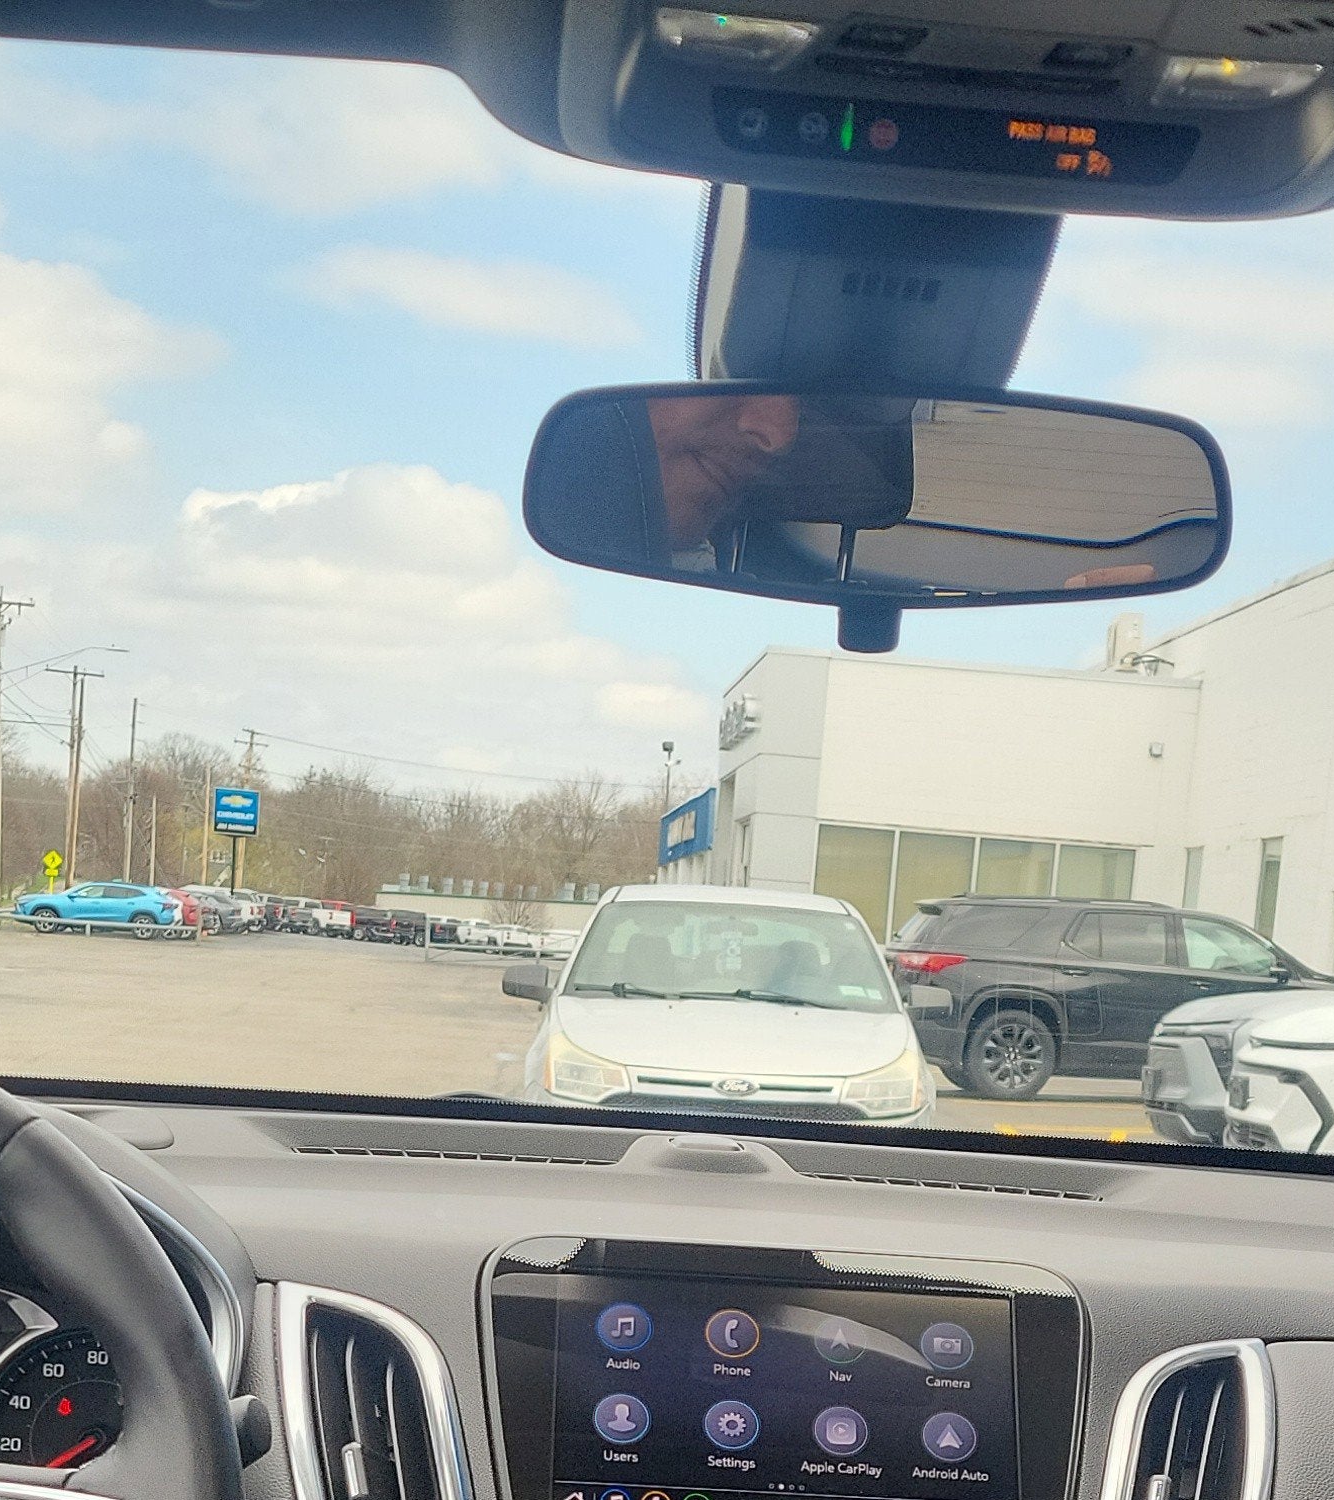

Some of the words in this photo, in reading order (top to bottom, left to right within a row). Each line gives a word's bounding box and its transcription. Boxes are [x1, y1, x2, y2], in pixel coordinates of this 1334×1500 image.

[87, 1350, 109, 1365] 80
[605, 1357, 641, 1371] Audio
[42, 1363, 65, 1378] 60
[713, 1363, 751, 1377] Phone
[829, 1370, 852, 1382] Nav
[925, 1375, 971, 1389] Camera
[8, 1395, 31, 1410] 40
[0, 1437, 21, 1452] 20
[603, 1450, 639, 1463] Users
[707, 1455, 756, 1472] Settings
[800, 1460, 835, 1475] Apple
[837, 1462, 883, 1479] CarPlay
[912, 1467, 959, 1480] Android
[961, 1469, 989, 1482] Auto
